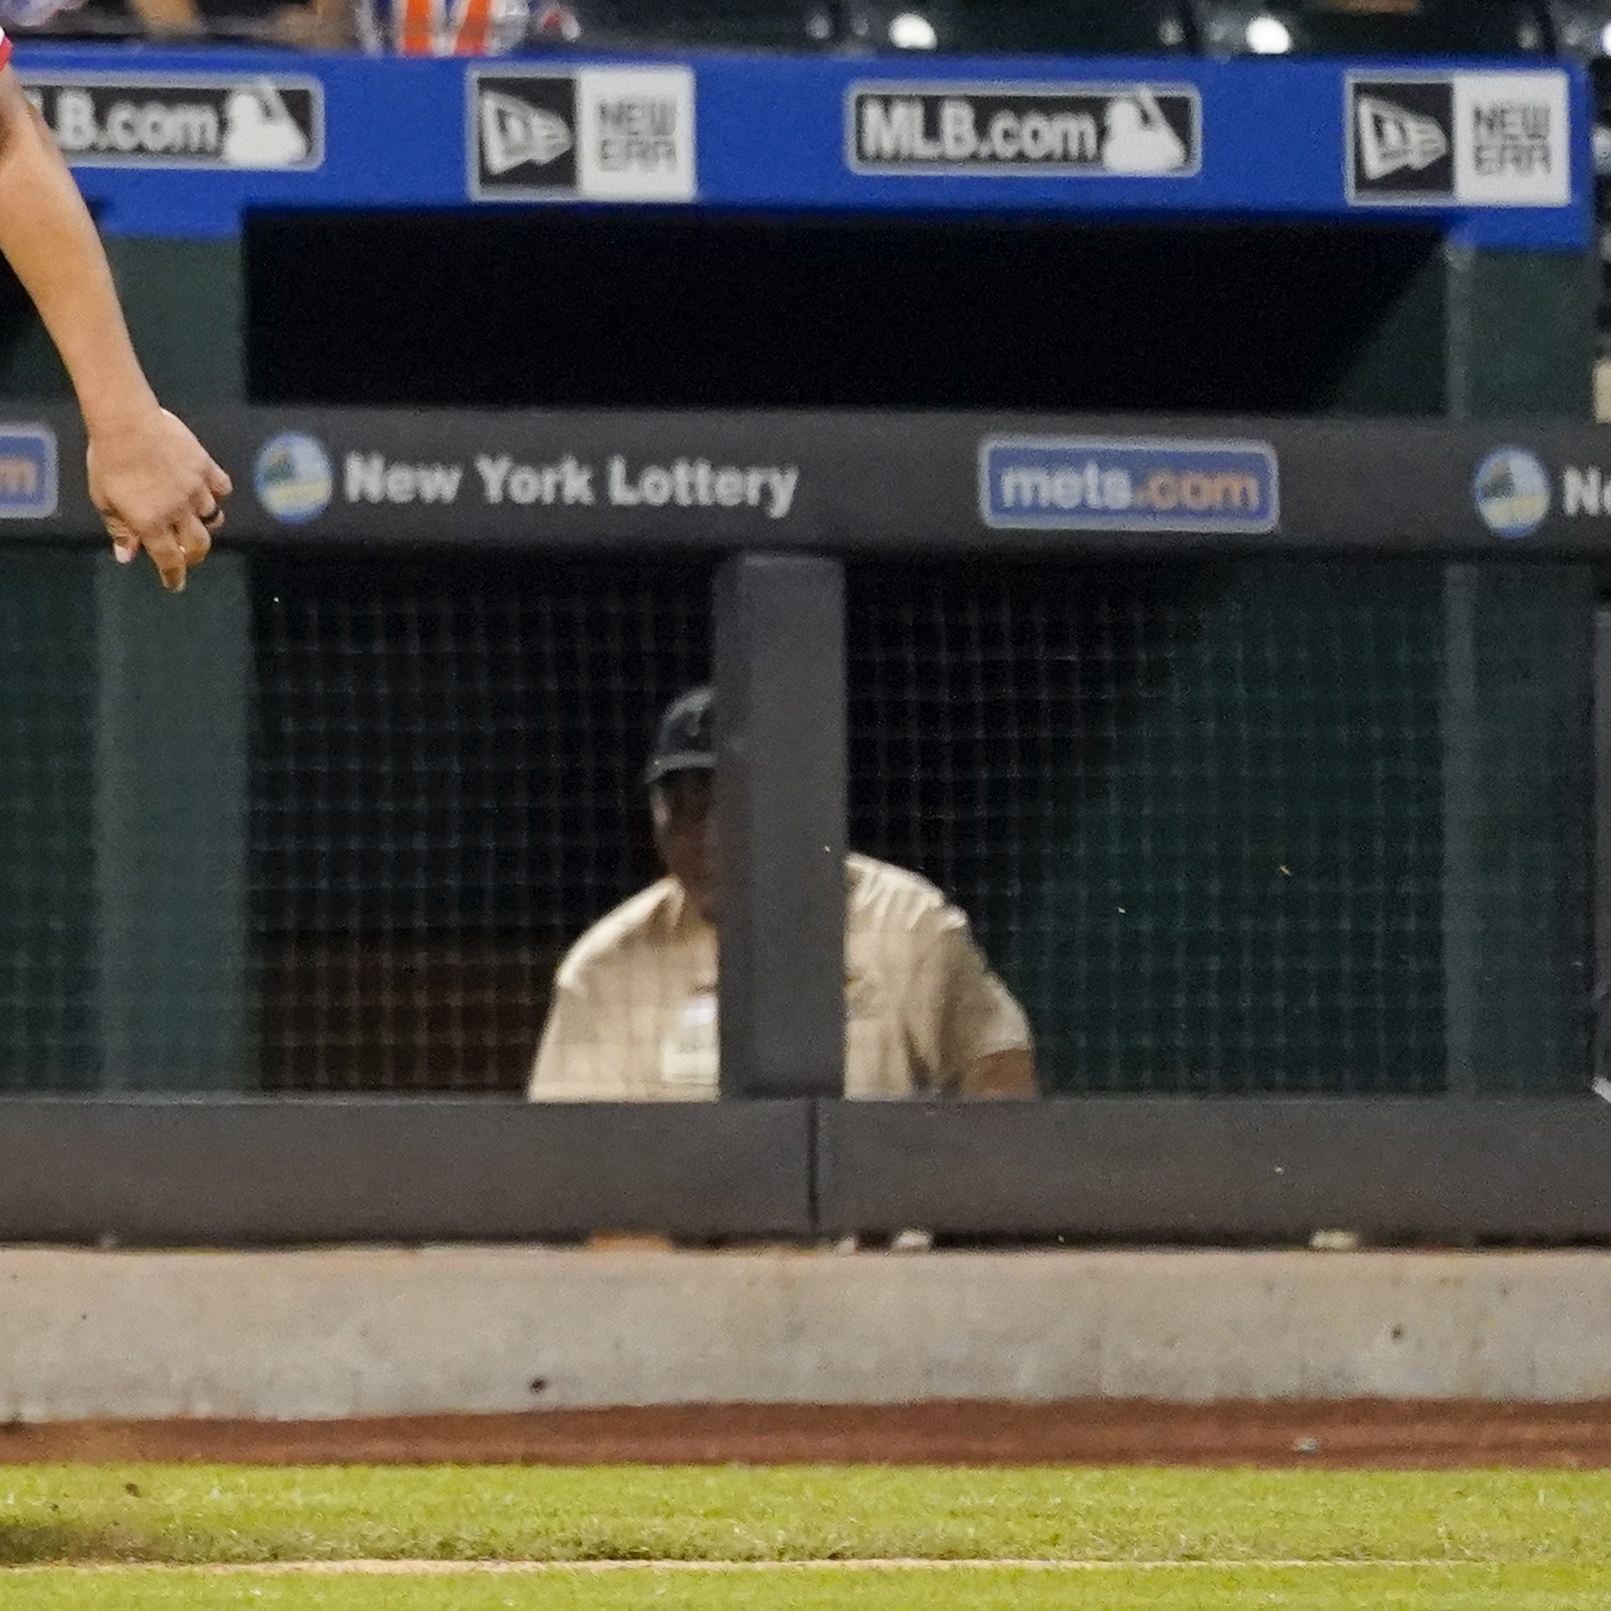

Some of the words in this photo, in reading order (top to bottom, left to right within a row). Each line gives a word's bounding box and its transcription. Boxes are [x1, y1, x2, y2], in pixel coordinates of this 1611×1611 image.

[860, 99, 1098, 160] MLB.com
[343, 450, 464, 505] New
[474, 452, 596, 507] York
[607, 452, 800, 520] Lottery
[1000, 459, 1260, 511] mets.com
